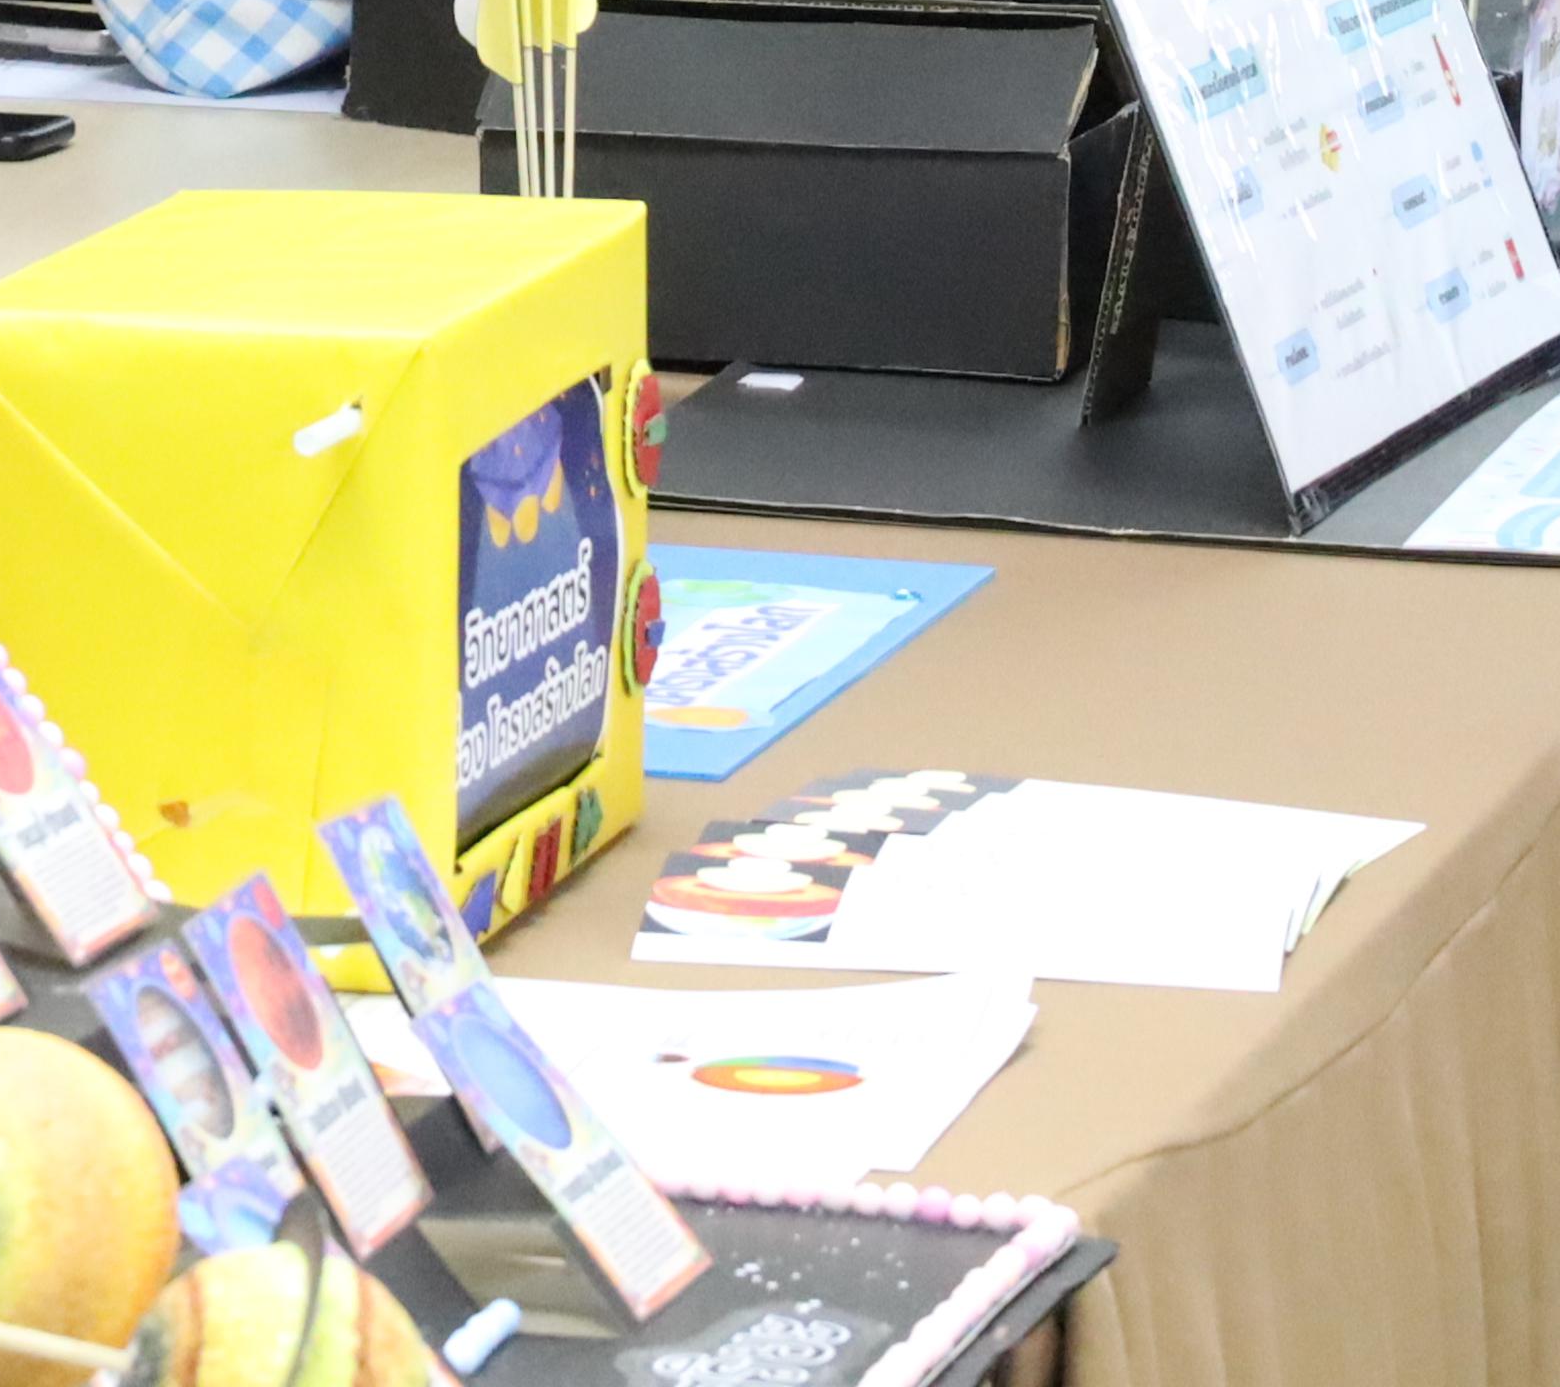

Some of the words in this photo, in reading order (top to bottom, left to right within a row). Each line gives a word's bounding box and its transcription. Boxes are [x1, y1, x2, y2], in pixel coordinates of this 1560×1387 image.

[465, 537, 593, 689] วิทยาศาสตร์
[486, 641, 608, 769] โครงสร้างโลก
